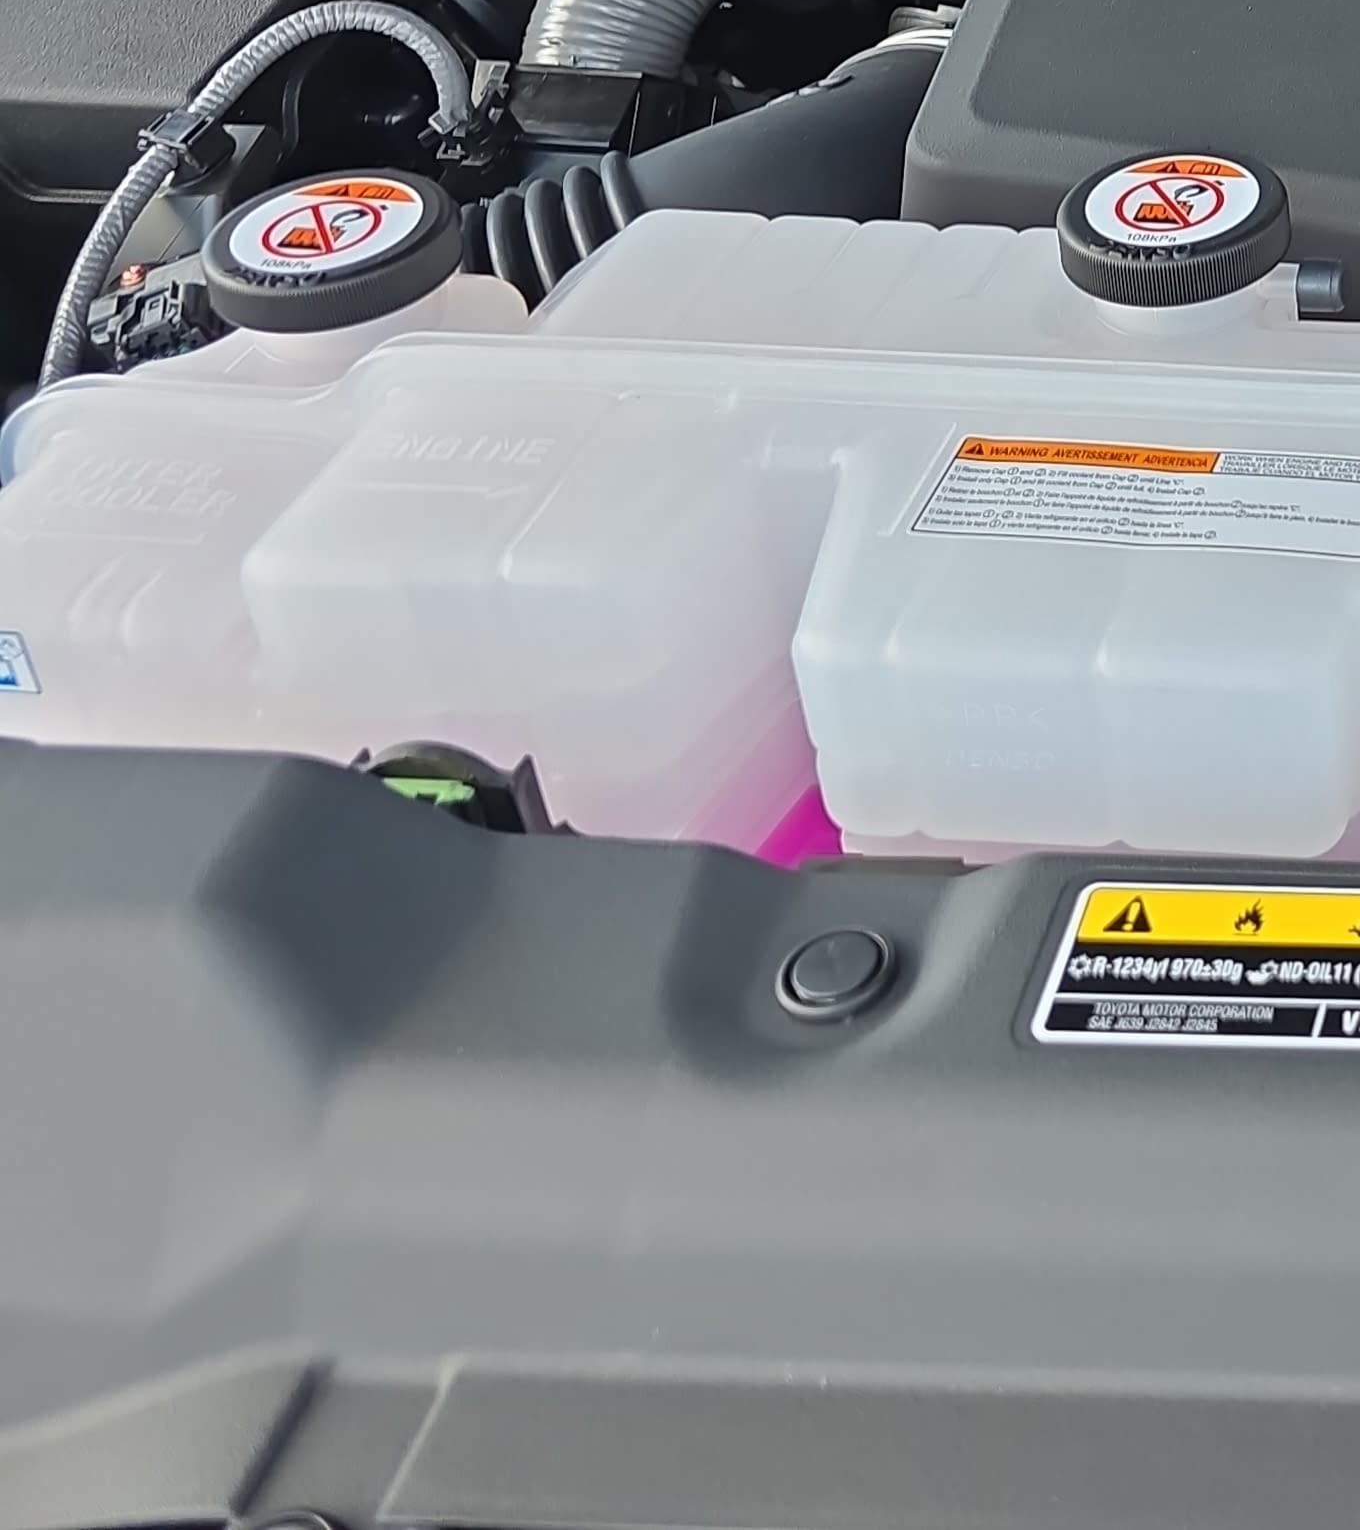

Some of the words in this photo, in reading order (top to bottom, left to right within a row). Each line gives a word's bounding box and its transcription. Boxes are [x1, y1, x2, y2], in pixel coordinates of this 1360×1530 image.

[1126, 233, 1178, 244] 108kPa
[989, 446, 1049, 457] WARNING
[1052, 447, 1139, 463] AVERTISSEMENT
[1143, 454, 1208, 468] ADVERTENCIA
[1170, 956, 1244, 986] 970±30g
[1093, 1001, 1141, 1016] TOYOTA
[1142, 1003, 1187, 1018] MOTOR
[1188, 1004, 1274, 1023] CORPORATION
[1087, 1015, 1114, 1030] SAE
[1114, 1016, 1144, 1031] J639
[1144, 1017, 1181, 1032] J2842
[1182, 1018, 1219, 1033] J2845
